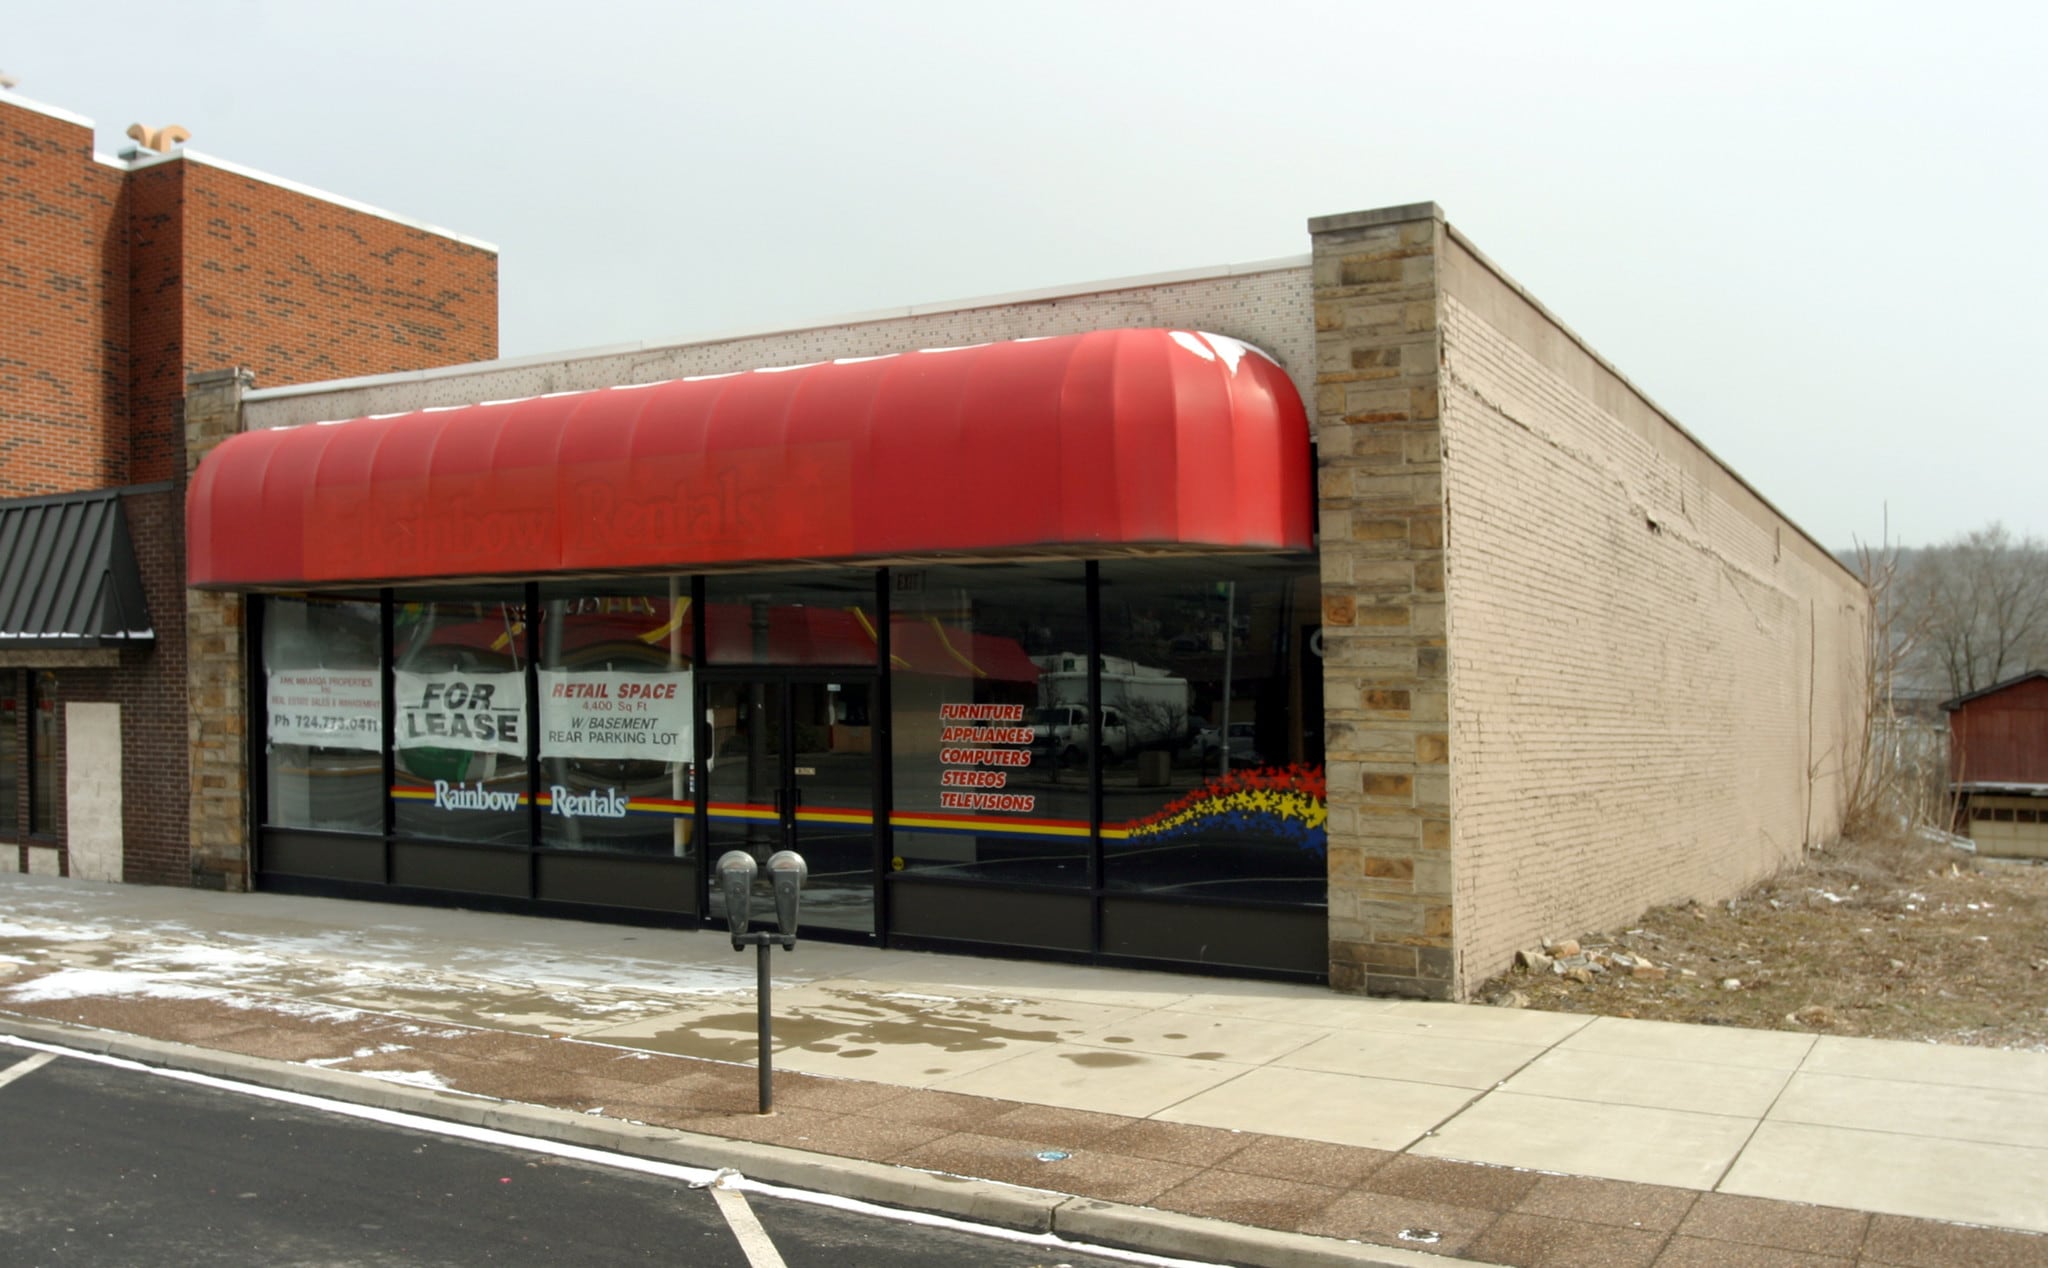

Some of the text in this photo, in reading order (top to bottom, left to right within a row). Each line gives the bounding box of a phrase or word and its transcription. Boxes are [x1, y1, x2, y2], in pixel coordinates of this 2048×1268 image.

[576, 468, 763, 551] Rentals
[421, 682, 496, 710] FOR
[552, 683, 677, 699] RETAIL SPACE
[583, 701, 647, 713] 4,400 Sq Ft
[940, 704, 1024, 720] FURNITURE
[274, 714, 290, 727] Ph
[407, 713, 519, 743] LEASE
[548, 730, 679, 745] REAR PARKING LOT
[941, 727, 1035, 744] APPLIANCES
[940, 748, 1032, 767] COMPUTERS
[941, 770, 1007, 788] STEREOS
[434, 779, 627, 817] Rainbow Rentals
[941, 792, 1035, 812] TELEVISIONS
